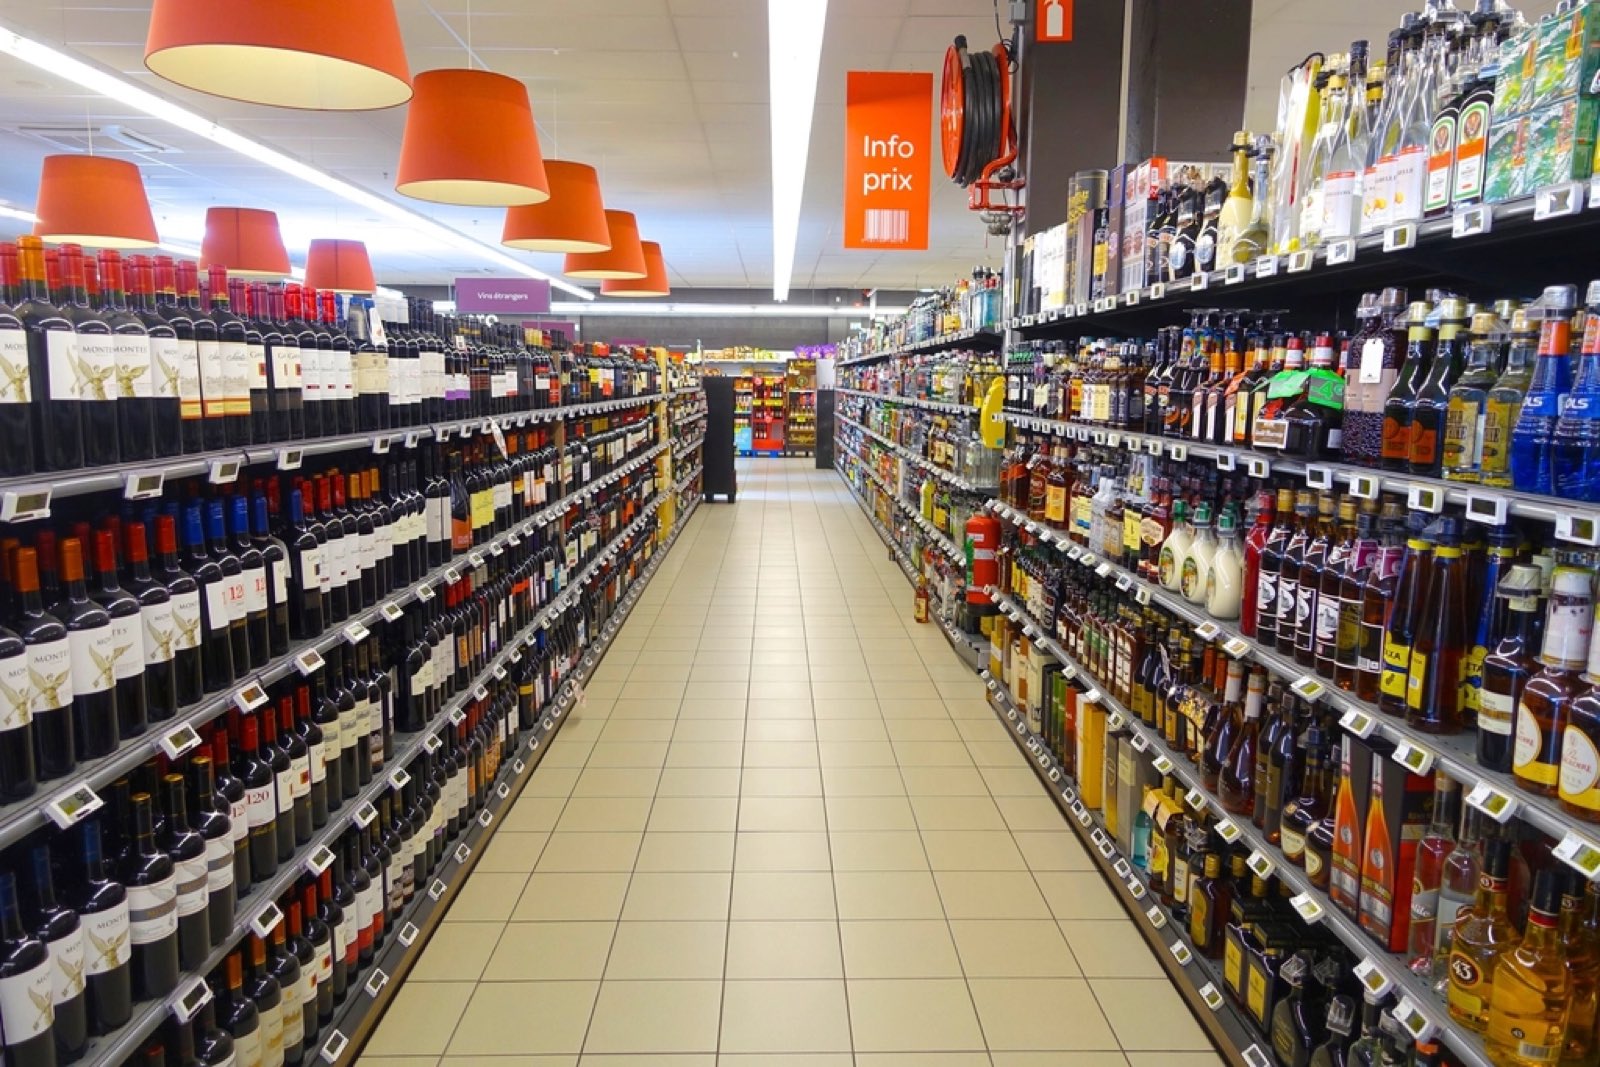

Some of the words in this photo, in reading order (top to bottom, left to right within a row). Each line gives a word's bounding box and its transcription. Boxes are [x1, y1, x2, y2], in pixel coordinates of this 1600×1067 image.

[863, 134, 914, 159] Info
[863, 168, 912, 196] prix
[477, 291, 493, 300] Vins
[495, 291, 529, 302] étrangers
